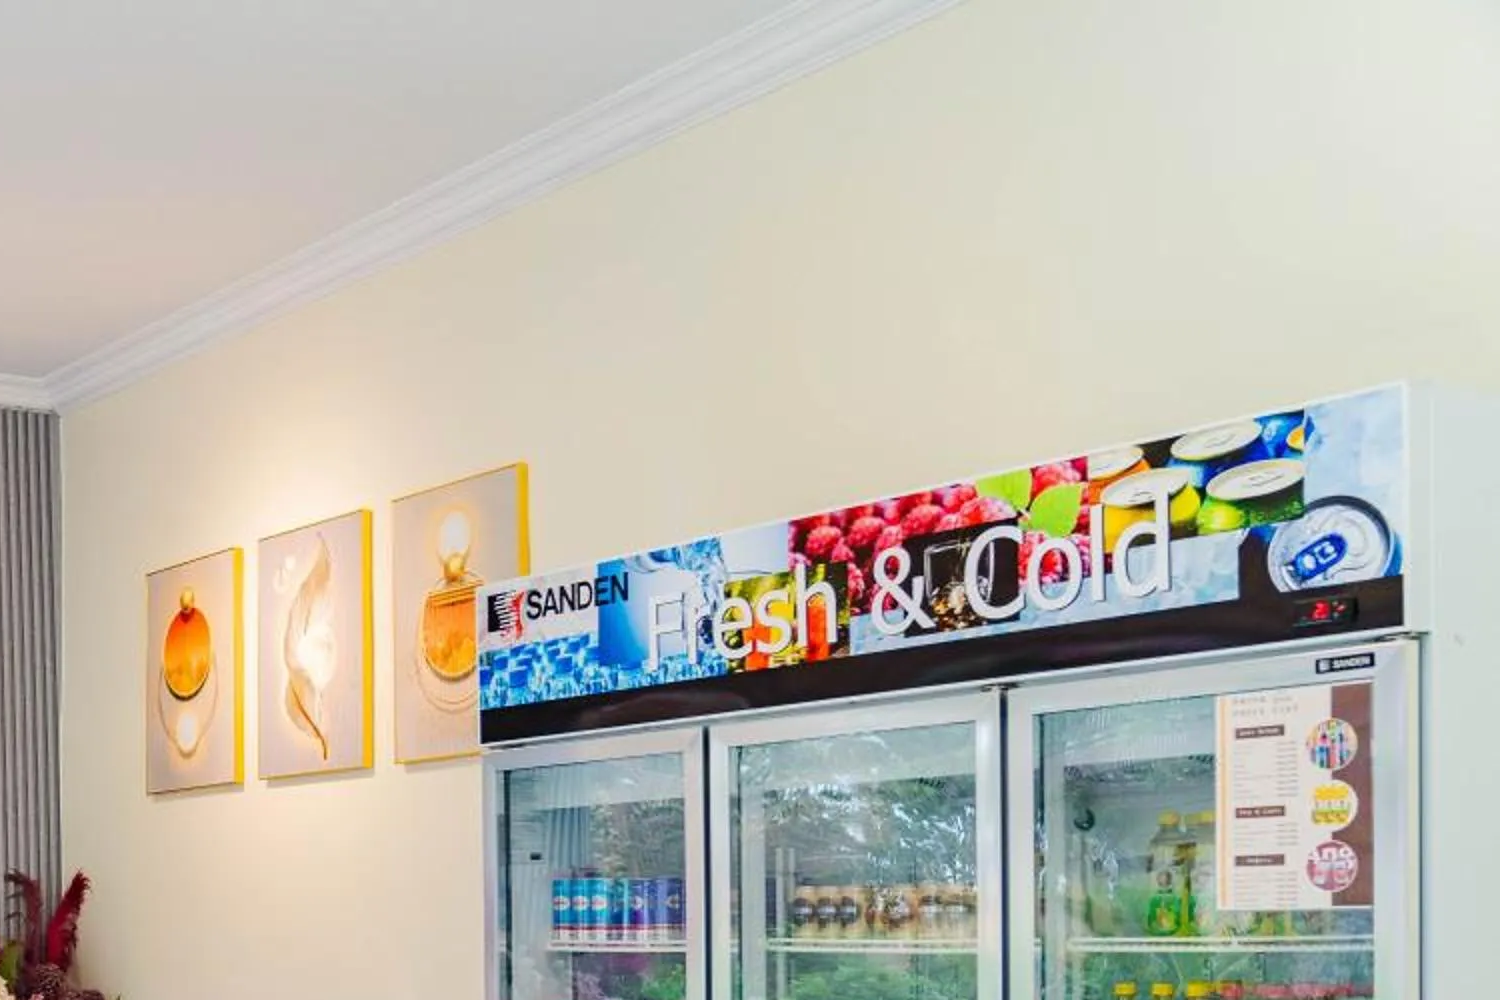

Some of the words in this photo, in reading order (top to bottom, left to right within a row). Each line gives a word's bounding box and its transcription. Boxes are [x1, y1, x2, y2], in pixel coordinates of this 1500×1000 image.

[526, 571, 629, 620] SANDEN
[646, 563, 838, 671] Fresh
[871, 545, 937, 629] &
[963, 488, 1172, 621] Cold
